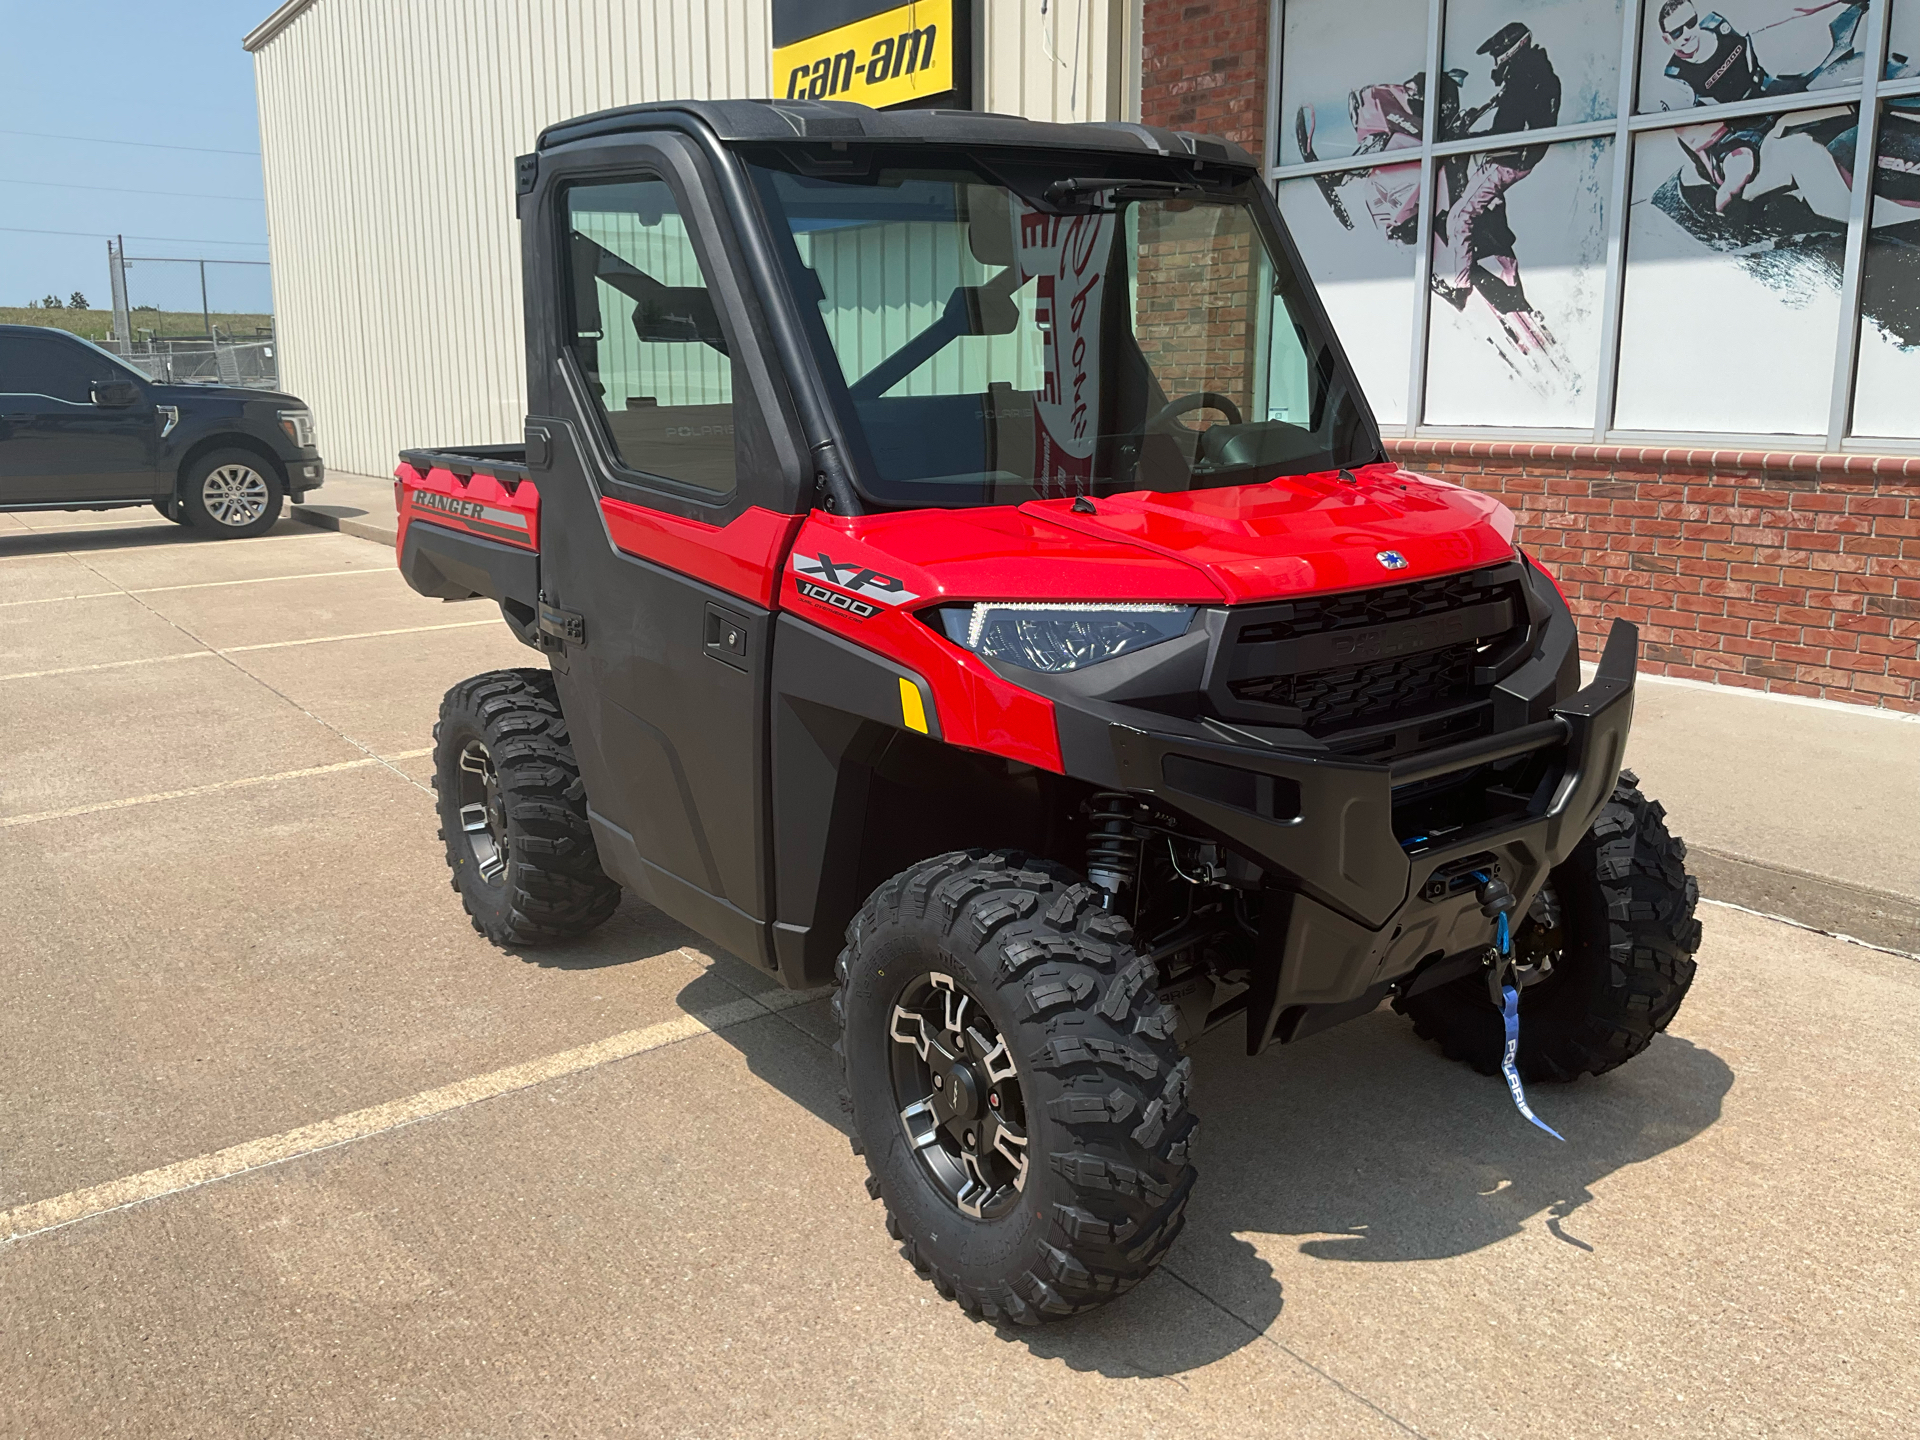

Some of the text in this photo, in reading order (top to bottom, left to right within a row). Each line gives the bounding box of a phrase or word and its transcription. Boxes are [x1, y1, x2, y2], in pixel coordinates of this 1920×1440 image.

[786, 23, 937, 100] can-am
[415, 489, 485, 520] RANGER
[796, 552, 904, 592] XP
[802, 583, 873, 617] 1000
[1331, 614, 1464, 662] POLARIS
[1503, 1038, 1534, 1120] POLARIS
